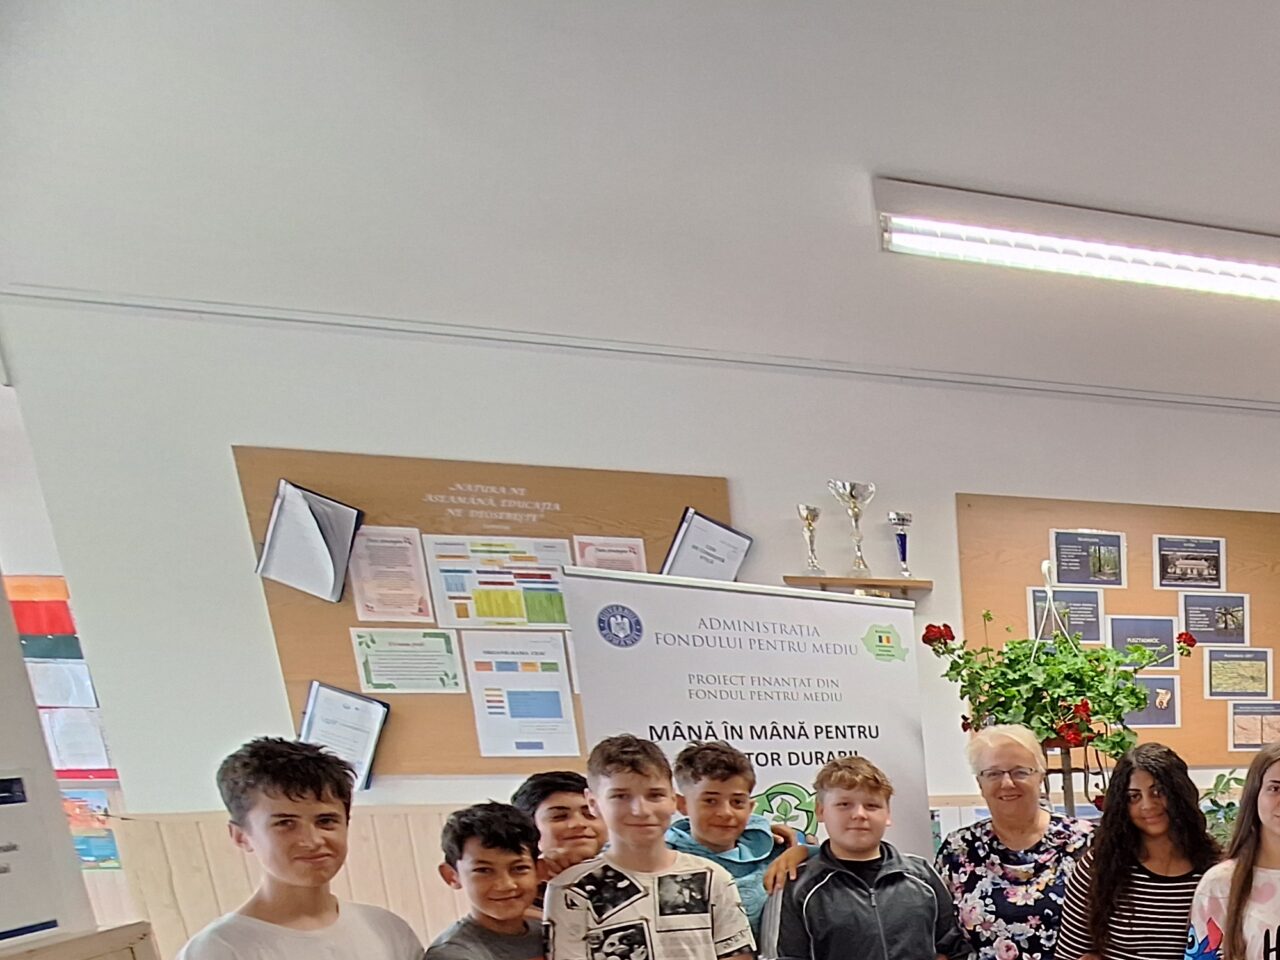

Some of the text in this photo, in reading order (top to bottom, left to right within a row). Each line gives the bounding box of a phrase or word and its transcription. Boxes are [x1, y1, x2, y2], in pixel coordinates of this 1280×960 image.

[654, 631, 743, 650] FONDULUI
[748, 637, 807, 653] PENTRU
[811, 642, 859, 656] MEDIU
[688, 673, 746, 687] PROIECT
[816, 678, 840, 689] DIN
[688, 688, 843, 703] FONDUL PENTRU MEDIU
[649, 721, 880, 741] MÂNĂ ÎN MÂNĂ PENTRU
